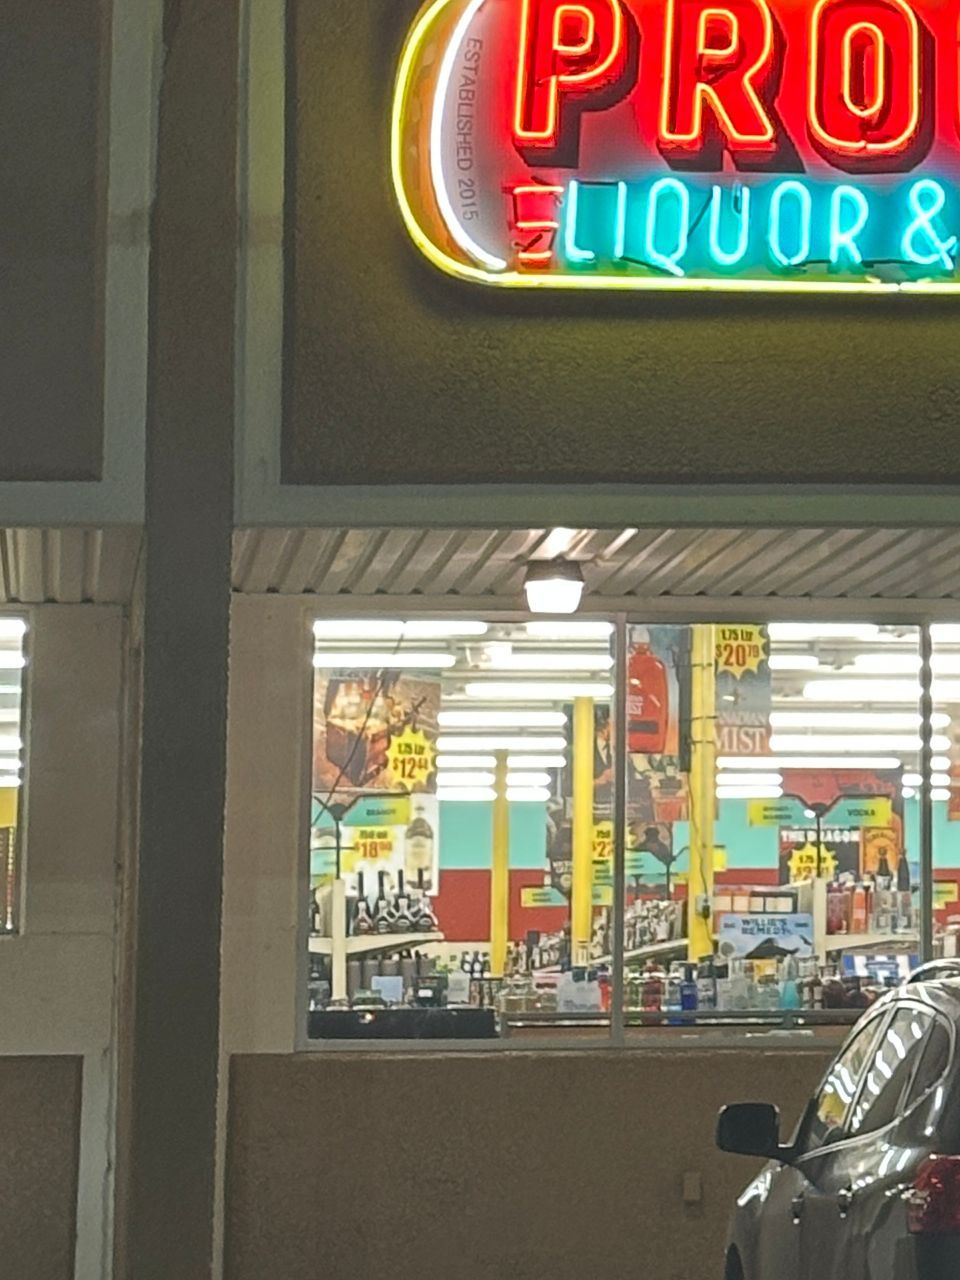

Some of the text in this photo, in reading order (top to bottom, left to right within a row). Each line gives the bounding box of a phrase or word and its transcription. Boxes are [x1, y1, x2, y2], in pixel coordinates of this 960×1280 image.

[455, 37, 483, 221] ESTABLISHED 2015
[564, 177, 868, 277] LIQUOR
[901, 179, 958, 271] &
